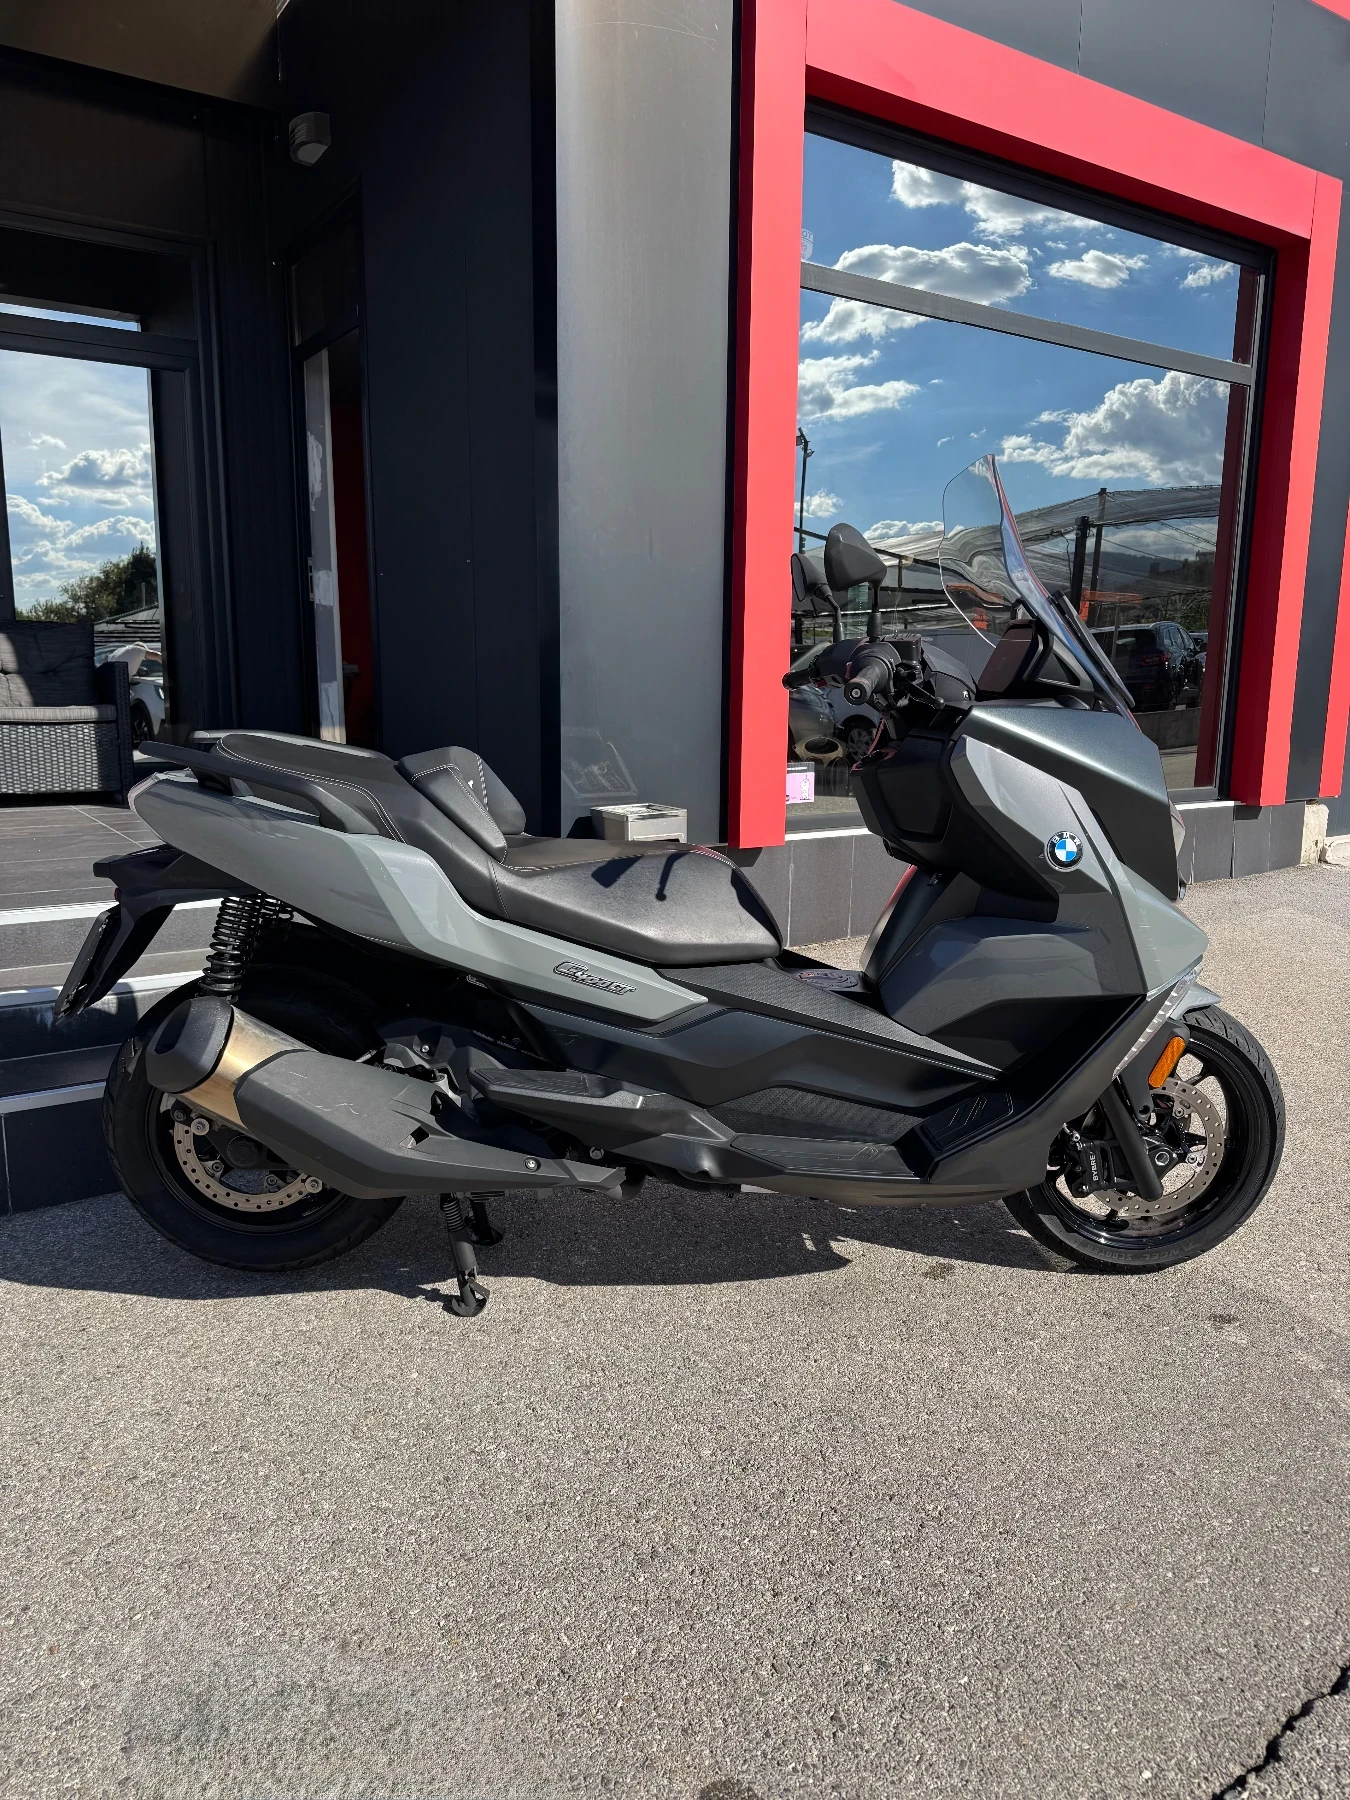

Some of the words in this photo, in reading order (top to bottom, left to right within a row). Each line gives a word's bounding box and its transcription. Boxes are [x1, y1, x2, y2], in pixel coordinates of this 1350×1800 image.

[1051, 831, 1081, 845] BMW
[1091, 1154, 1099, 1182] BYBRE
[1085, 1244, 1132, 1261] SCOOTER
